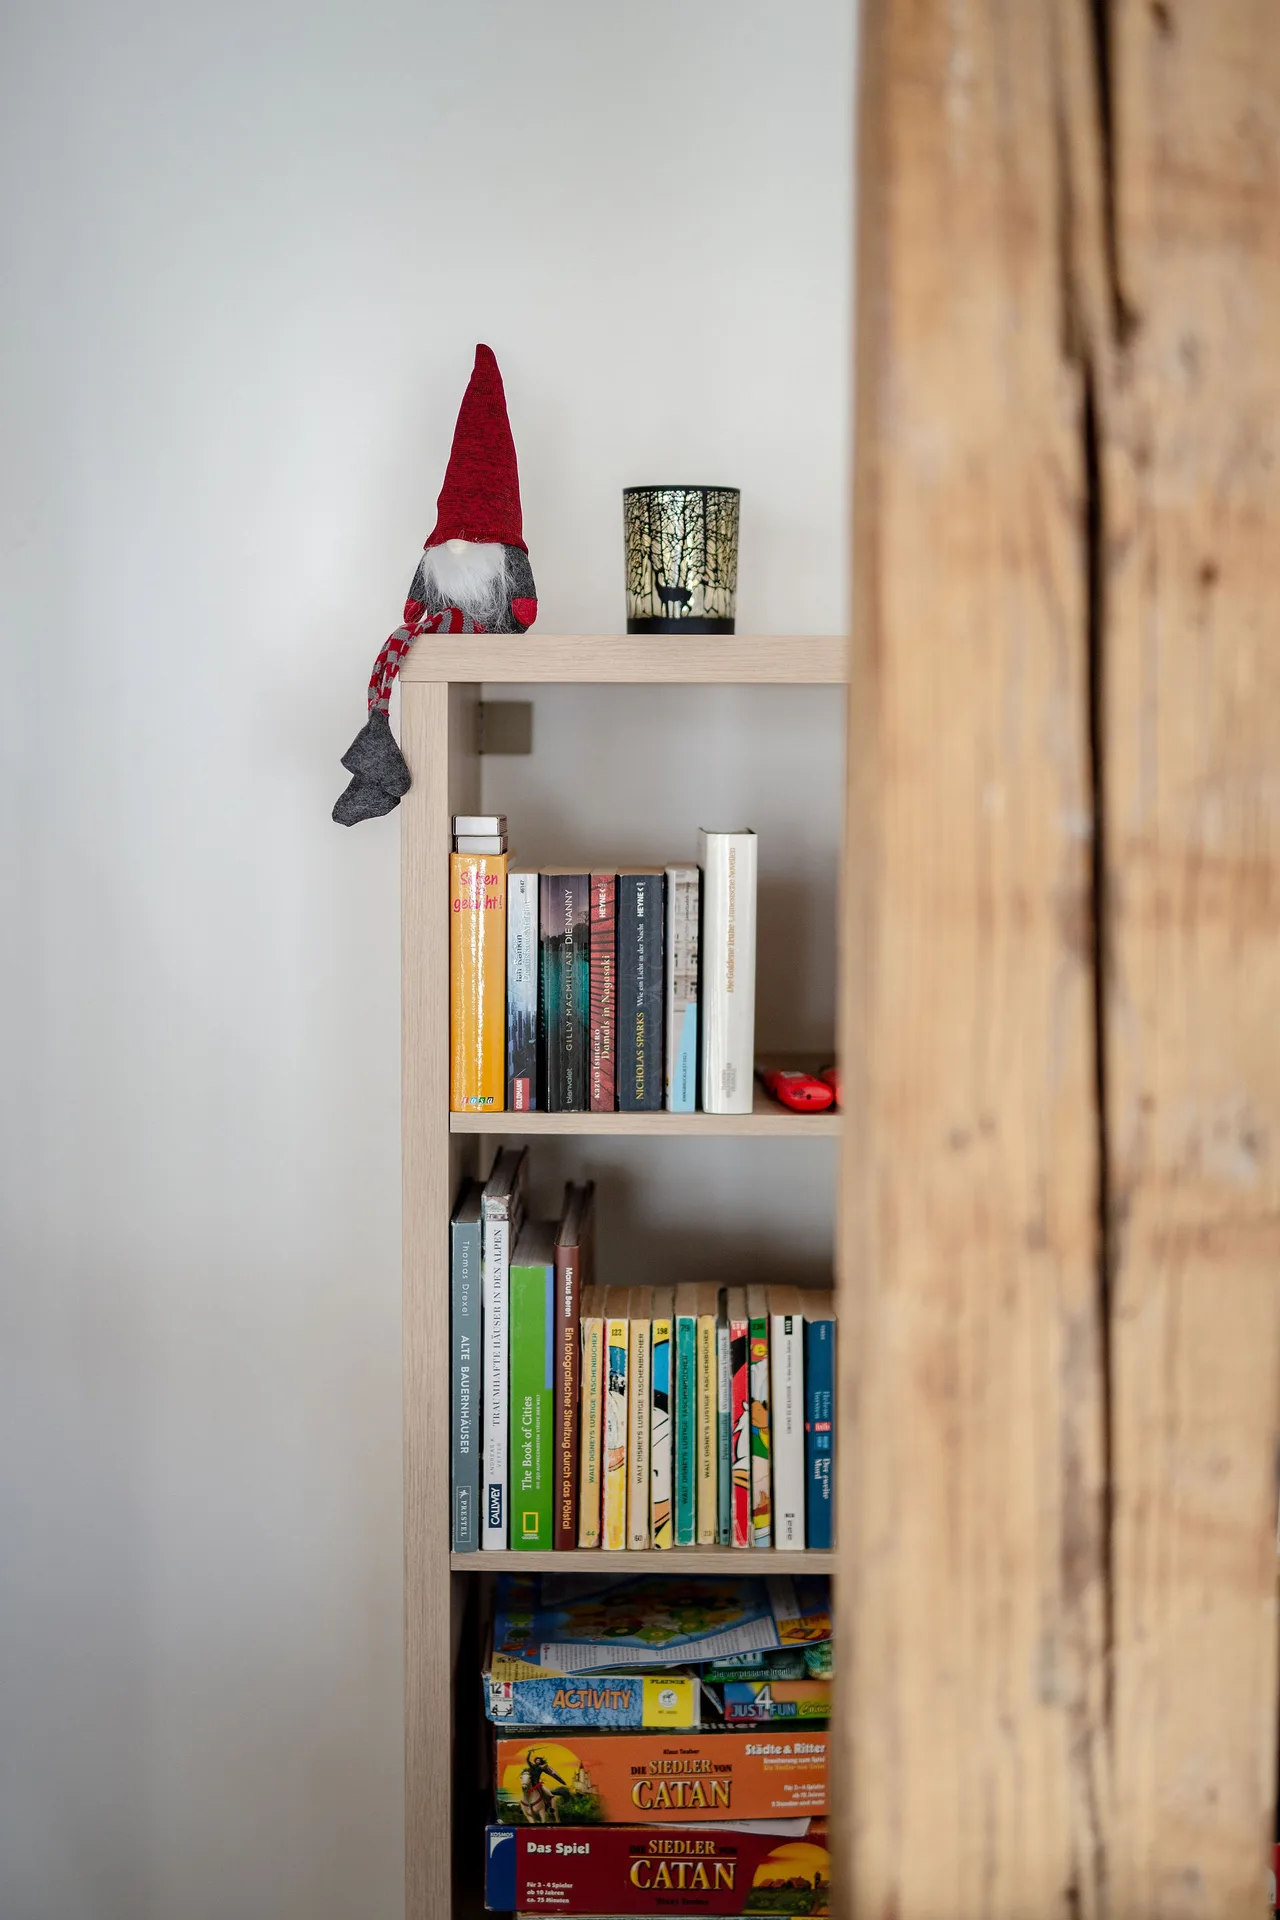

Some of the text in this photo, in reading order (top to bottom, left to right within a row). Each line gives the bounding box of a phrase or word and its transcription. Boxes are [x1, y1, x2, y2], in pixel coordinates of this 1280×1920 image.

[564, 889, 573, 945] DIE NANNY
[636, 924, 644, 942] Nacht
[513, 935, 523, 982] Ian Rankin
[636, 944, 644, 954] der
[725, 948, 735, 979] Goldene
[565, 951, 573, 1016] MACMILLAN
[636, 963, 644, 980] Licht
[725, 980, 734, 994] Die
[601, 955, 613, 1059] Damals in Nagasaki
[636, 993, 644, 1006] Wie
[635, 1012, 644, 1100] NICHOLAS SPARKS
[515, 1080, 523, 1109] GOLDMANN
[565, 1068, 573, 1104] blanvalet
[461, 1240, 470, 1317] Thomas Drexel
[565, 1267, 573, 1317] Markus Beren
[491, 1229, 502, 1427] TRAUMHAFTE HÄUSER IN DEN ALPEN
[611, 1328, 622, 1336] 122
[680, 1324, 691, 1332] 79
[636, 1333, 644, 1396] TASCHENBÜCHER
[460, 1334, 472, 1454] ALTE BAUERNHÄUSER
[520, 1396, 533, 1491] The Book of Cities
[561, 1327, 574, 1530] Ein fotografischer Streifzug durch das Pölstal
[588, 1430, 596, 1462] DISNEYS
[681, 1452, 689, 1483] DISNEYS
[821, 1458, 831, 1474] Der
[460, 1500, 468, 1537] PRESTEL
[490, 1487, 501, 1521] CALLWEY
[552, 1688, 632, 1710] ACTIVITY
[731, 1703, 766, 1718] JUST
[754, 1683, 774, 1711] 4
[769, 1703, 797, 1717] FUN
[745, 1742, 827, 1756] Städte & Ritter
[630, 1759, 733, 1775] DIE SIEDLER VON
[630, 1779, 733, 1810] CATAN
[526, 1842, 591, 1856] Das Spiel
[629, 1845, 646, 1855] DIE
[648, 1839, 717, 1855] SIEDLER
[526, 1881, 537, 1889] Für
[551, 1882, 574, 1890] Spieler
[629, 1859, 737, 1892] CATAN
